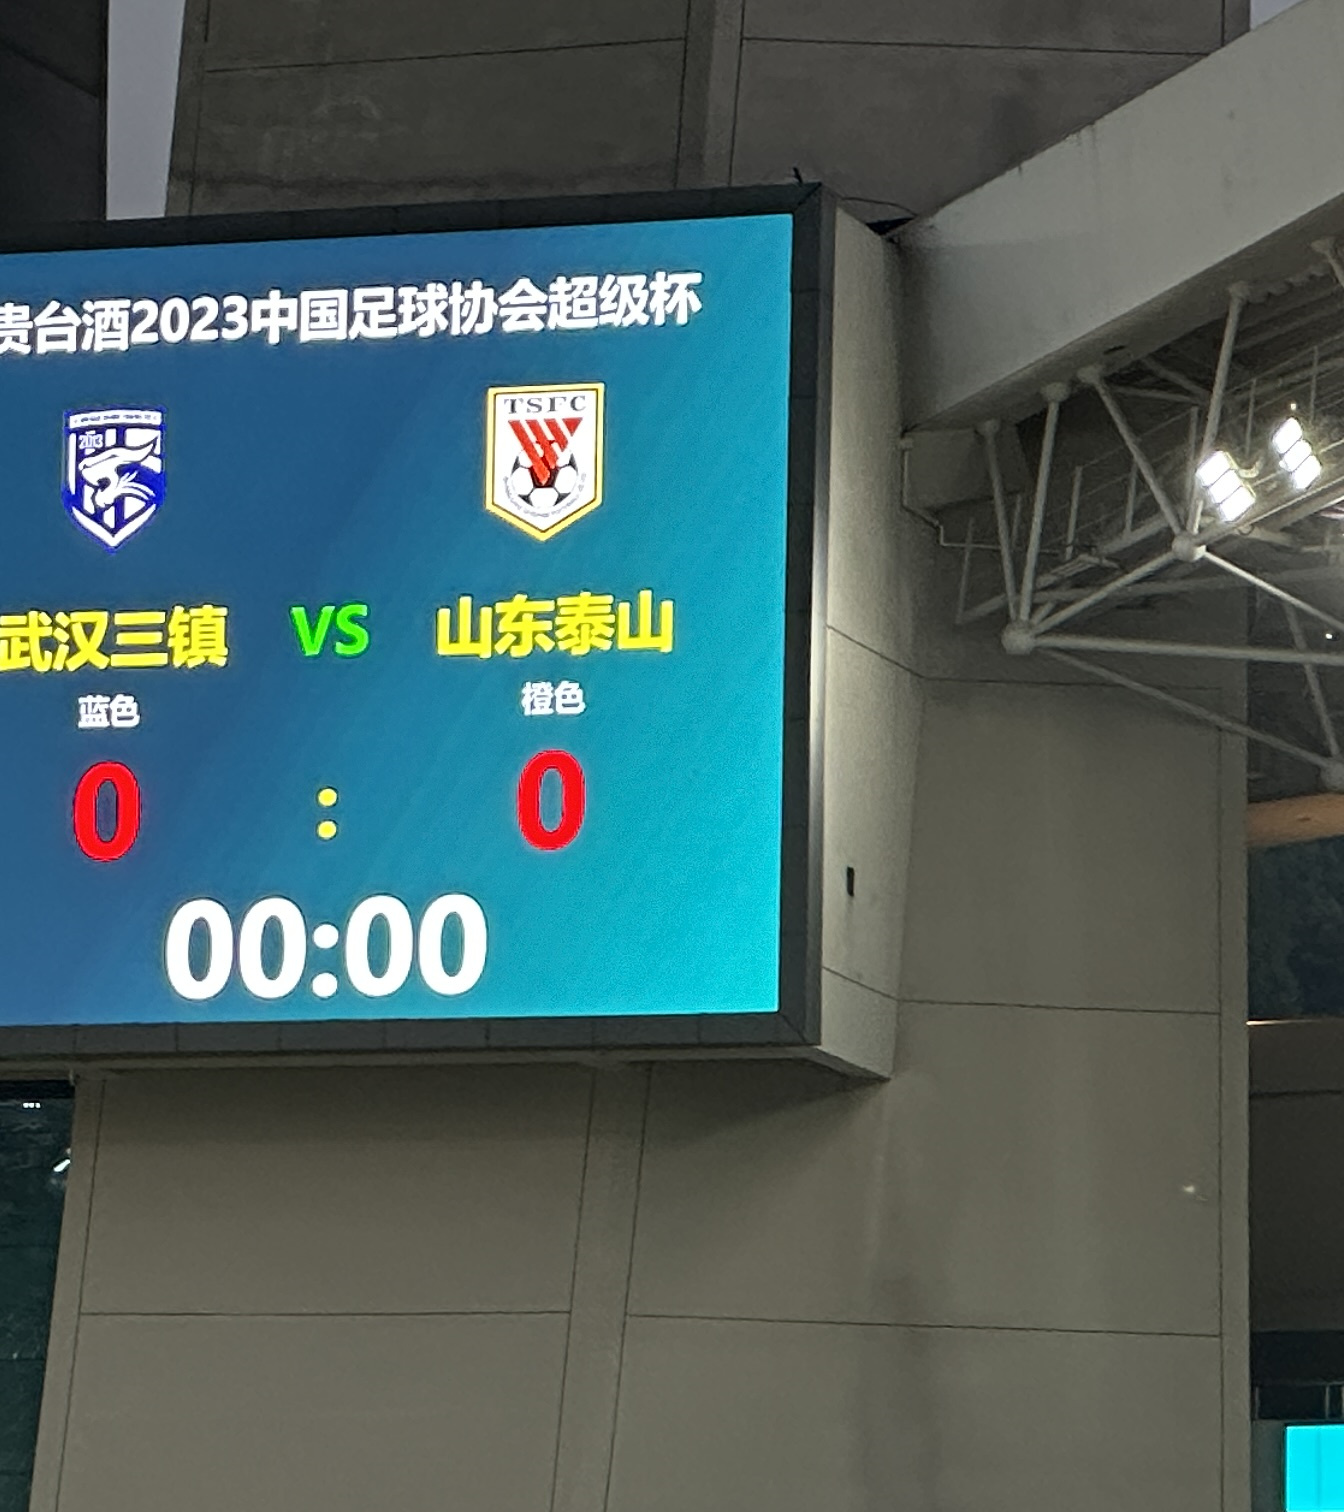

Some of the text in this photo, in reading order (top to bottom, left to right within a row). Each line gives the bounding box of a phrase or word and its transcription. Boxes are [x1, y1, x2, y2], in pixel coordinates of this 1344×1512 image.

[503, 394, 587, 415] TSFC
[290, 603, 370, 657] VS
[435, 589, 675, 659] 山东泰山
[76, 693, 142, 730] 蓝色
[519, 679, 587, 717] 橙色
[71, 761, 142, 862] 0
[515, 749, 587, 852] 0
[164, 893, 488, 1001] 00:00
